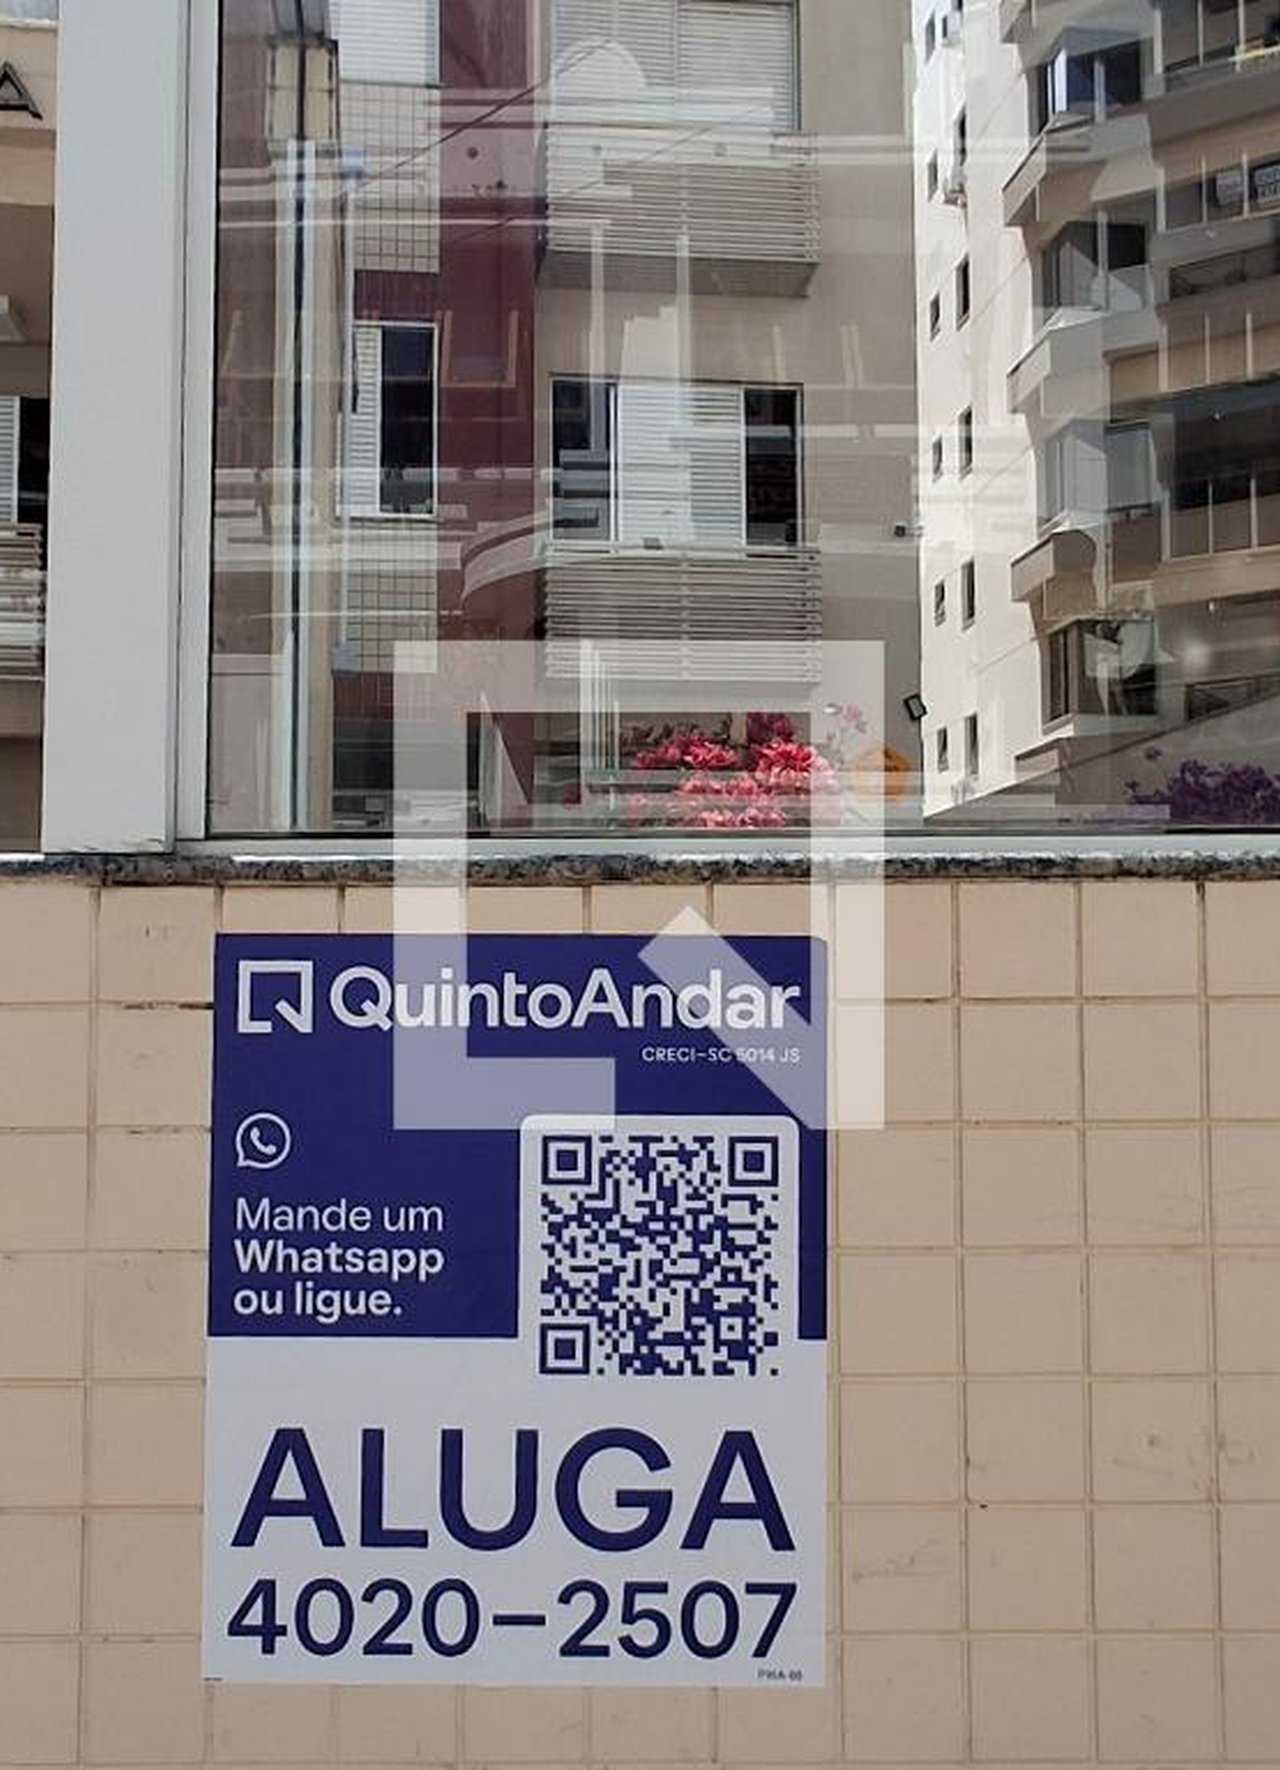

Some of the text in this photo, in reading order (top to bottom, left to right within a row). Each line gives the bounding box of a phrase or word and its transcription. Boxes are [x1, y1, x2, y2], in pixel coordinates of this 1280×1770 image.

[329, 965, 801, 1030] QuintoAndar
[780, 1047, 801, 1063] JS
[236, 1199, 444, 1232] Mande um
[235, 1239, 445, 1281] Whatsapp
[234, 1281, 403, 1324] ou ligue.
[231, 1427, 796, 1552] ALUGA
[227, 1578, 798, 1659] 4020-2507
